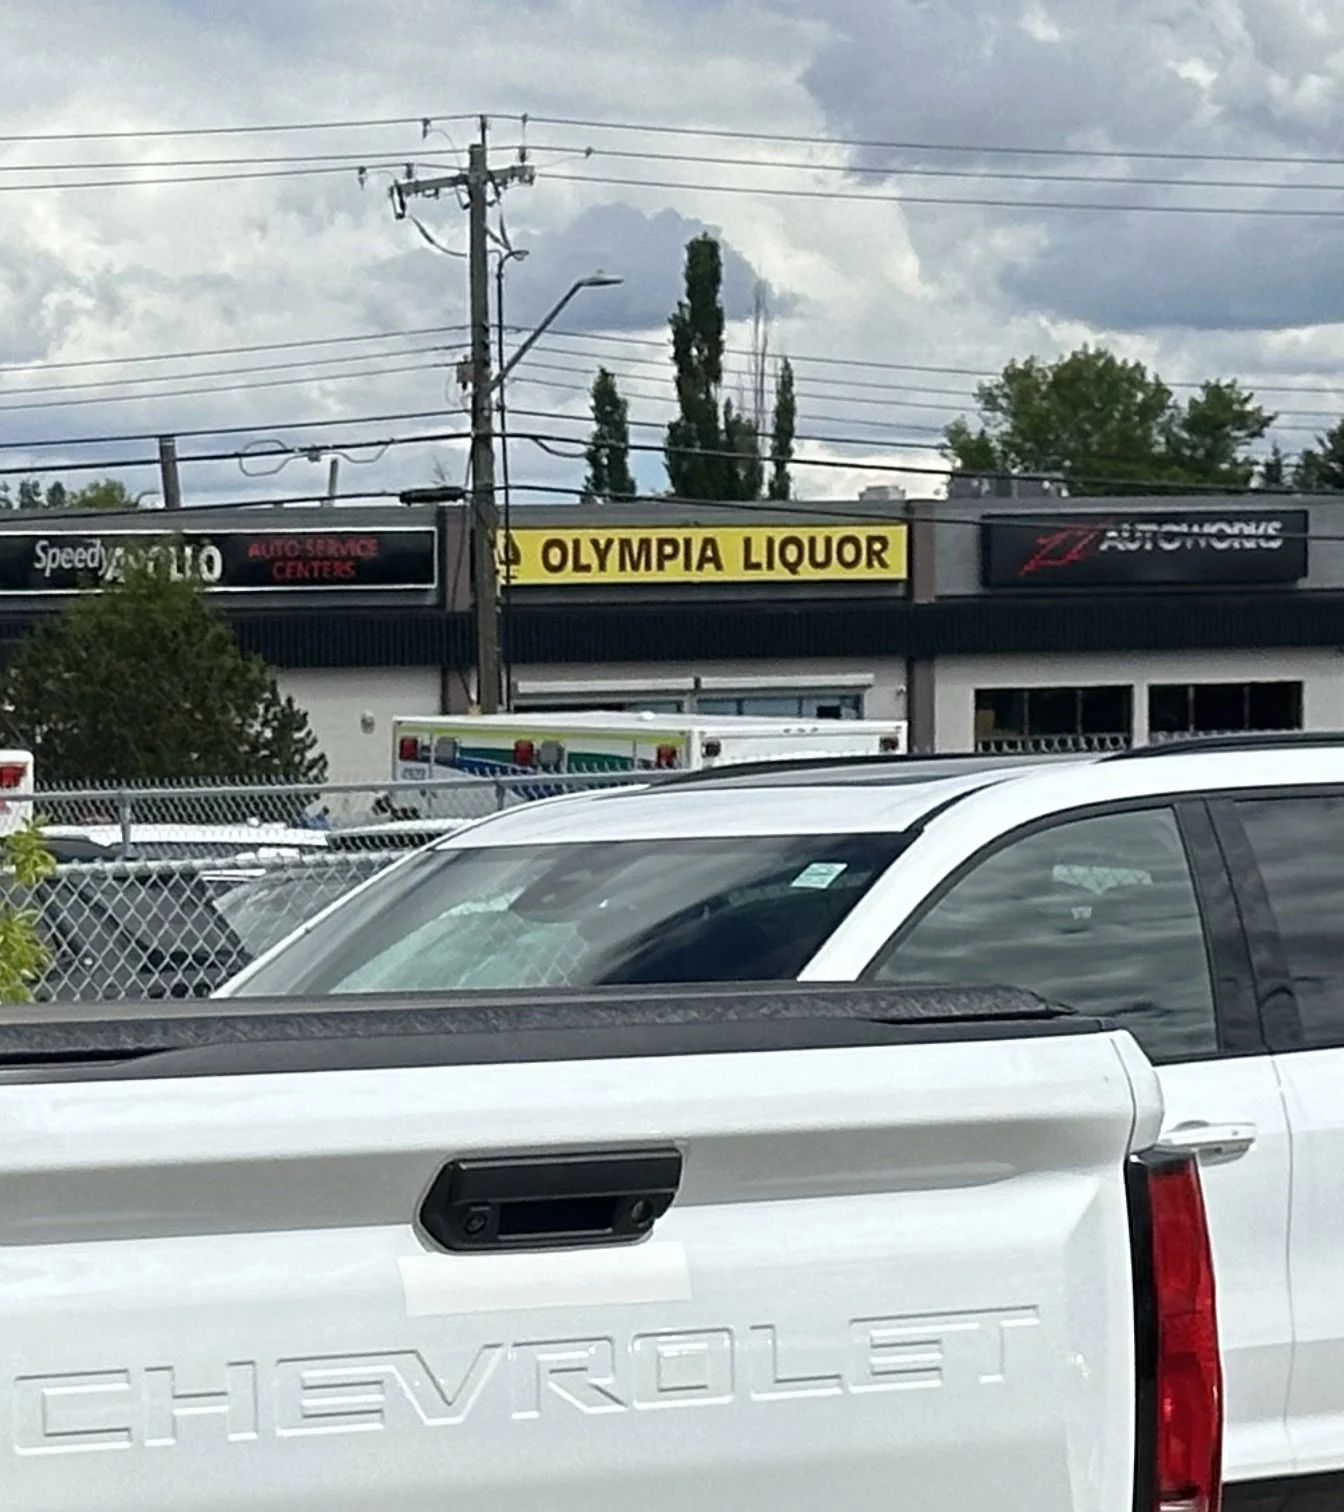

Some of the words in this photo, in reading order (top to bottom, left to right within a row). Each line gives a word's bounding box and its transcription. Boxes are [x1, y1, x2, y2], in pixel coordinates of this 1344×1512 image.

[247, 542, 301, 559] AUTO
[305, 536, 379, 558] SERVICE
[1099, 520, 1285, 551] AUTOWORKS
[33, 538, 108, 578] Speedy
[272, 560, 357, 580] CENTERS
[541, 536, 724, 573] OLYMPIA
[742, 534, 891, 576] LIQUOR
[14, 1304, 1040, 1455] CHEVROLET
